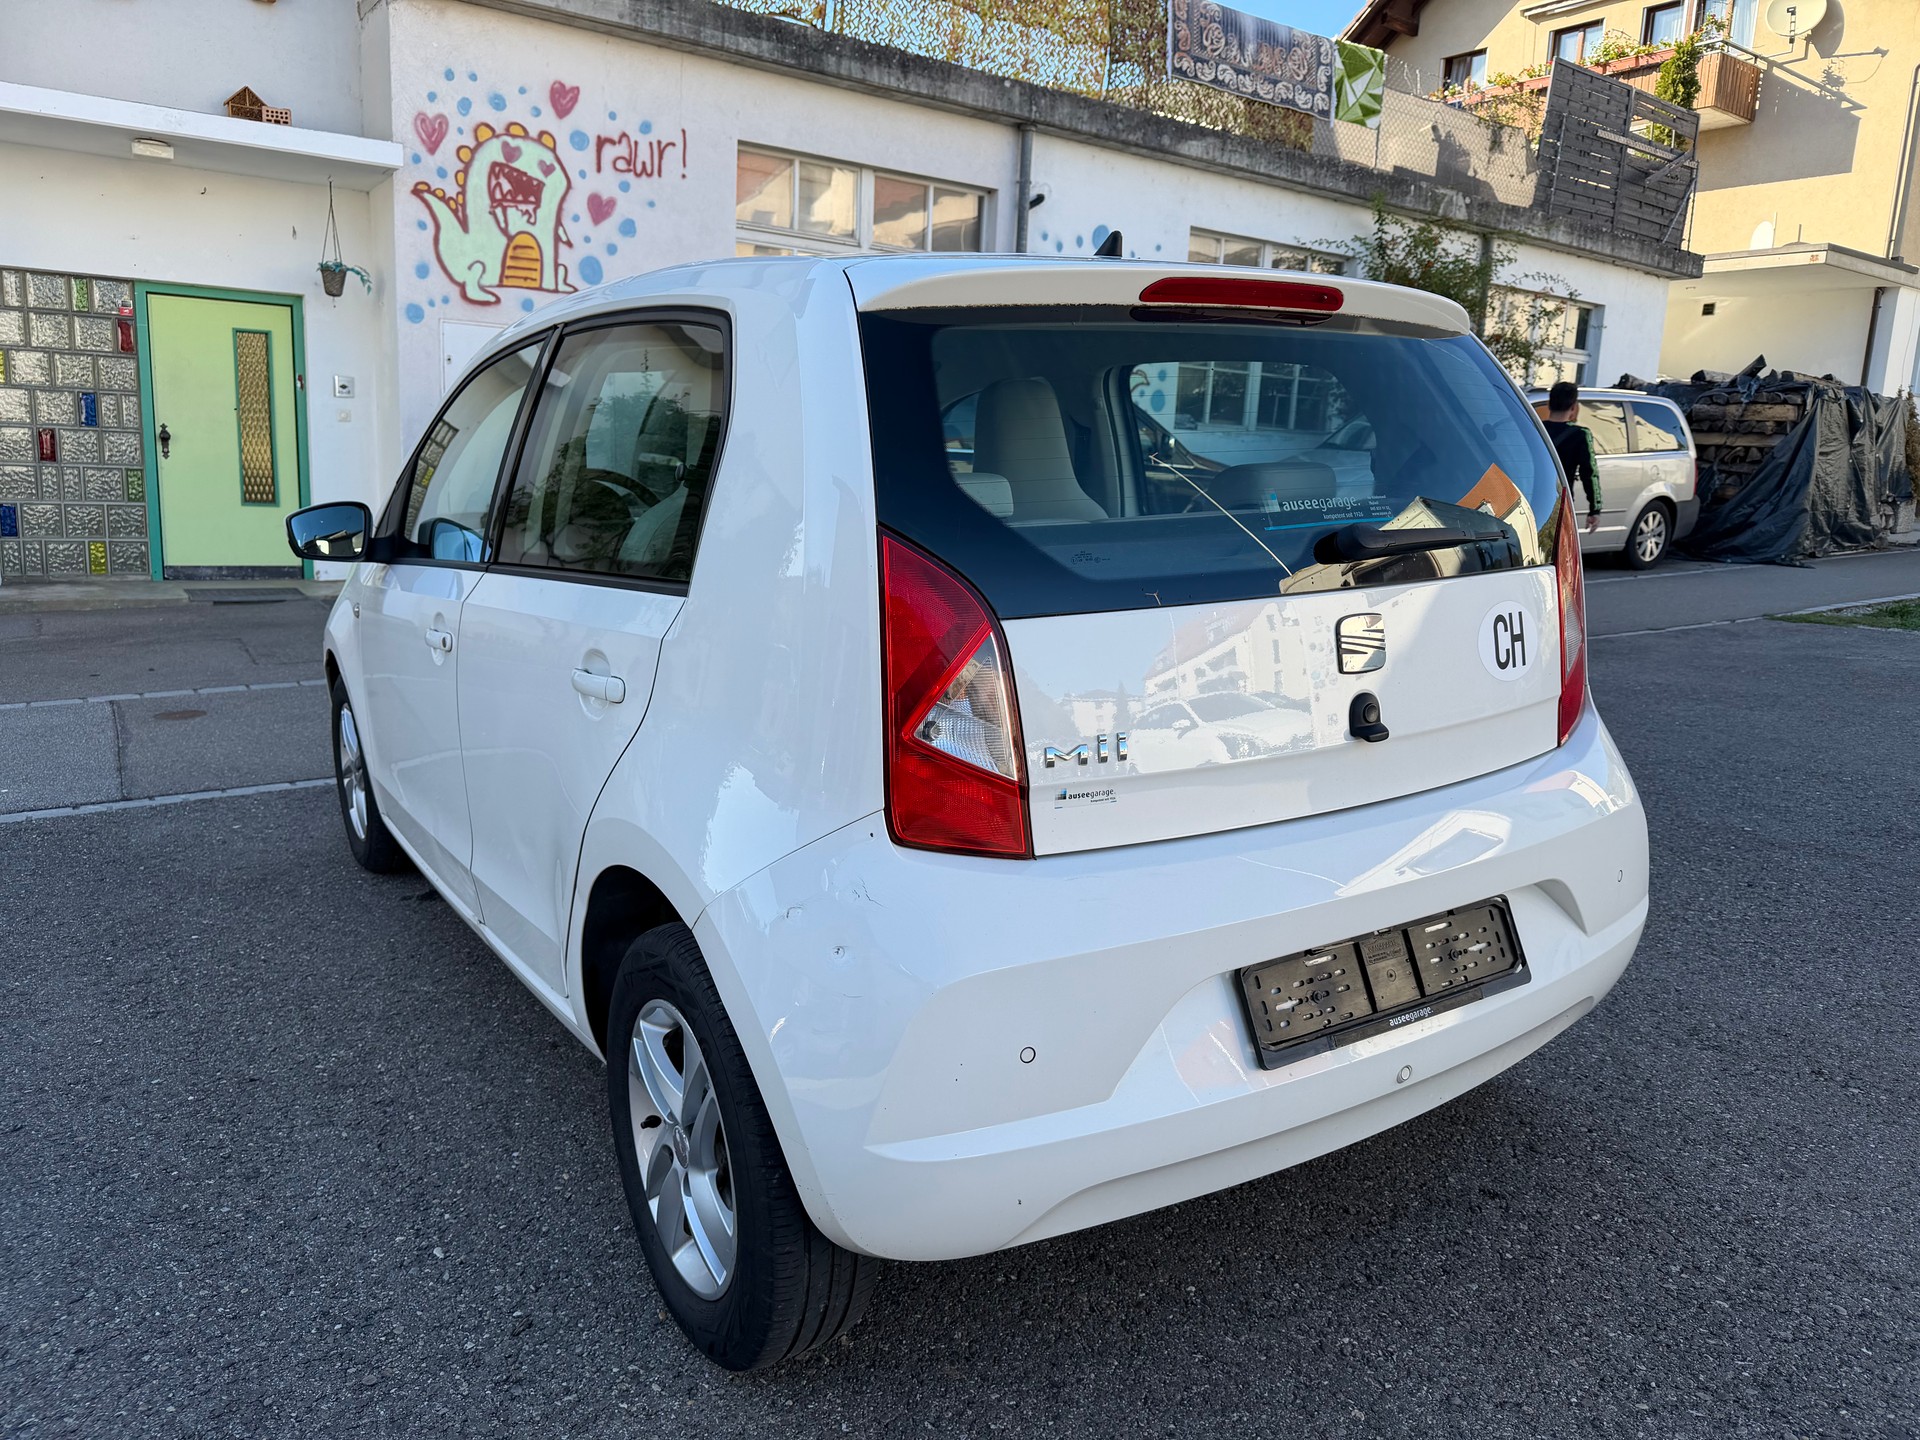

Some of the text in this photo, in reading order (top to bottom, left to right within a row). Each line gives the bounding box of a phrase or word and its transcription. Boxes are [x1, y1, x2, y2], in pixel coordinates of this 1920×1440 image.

[595, 128, 687, 179] rawr!
[1282, 496, 1361, 512] auseegarage.
[1493, 611, 1526, 670] CH
[1067, 788, 1117, 800] auseegarage.
[1389, 1006, 1434, 1027] auseegarage.
